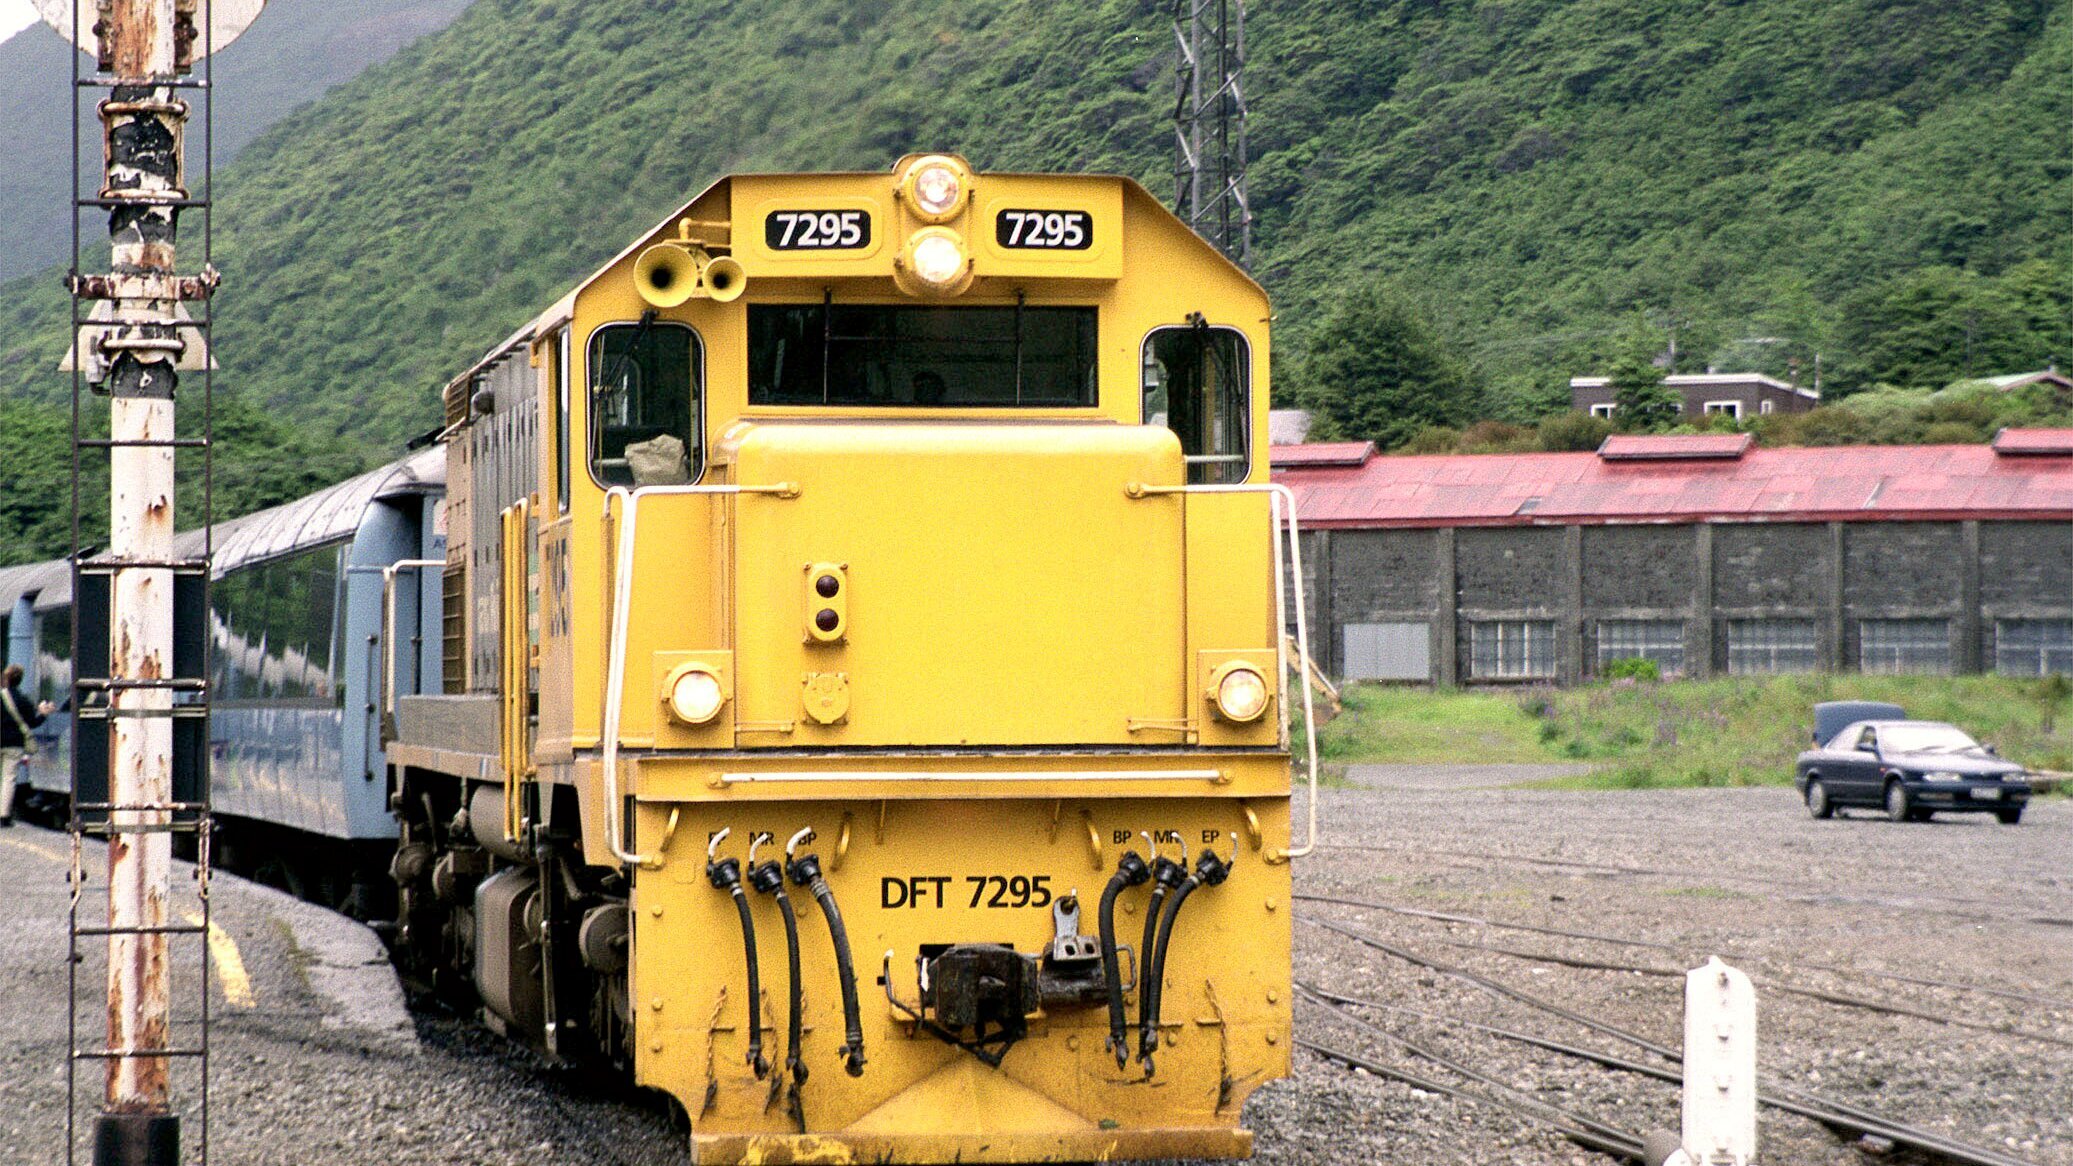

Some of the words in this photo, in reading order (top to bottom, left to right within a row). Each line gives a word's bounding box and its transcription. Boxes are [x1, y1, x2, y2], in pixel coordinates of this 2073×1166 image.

[776, 213, 861, 246] 7295
[1006, 213, 1084, 246] 7295
[1113, 830, 1132, 844] BP
[1154, 830, 1180, 844] MR
[1202, 830, 1220, 843] EP
[881, 877, 952, 908] DFT
[966, 876, 1052, 908] 7295
